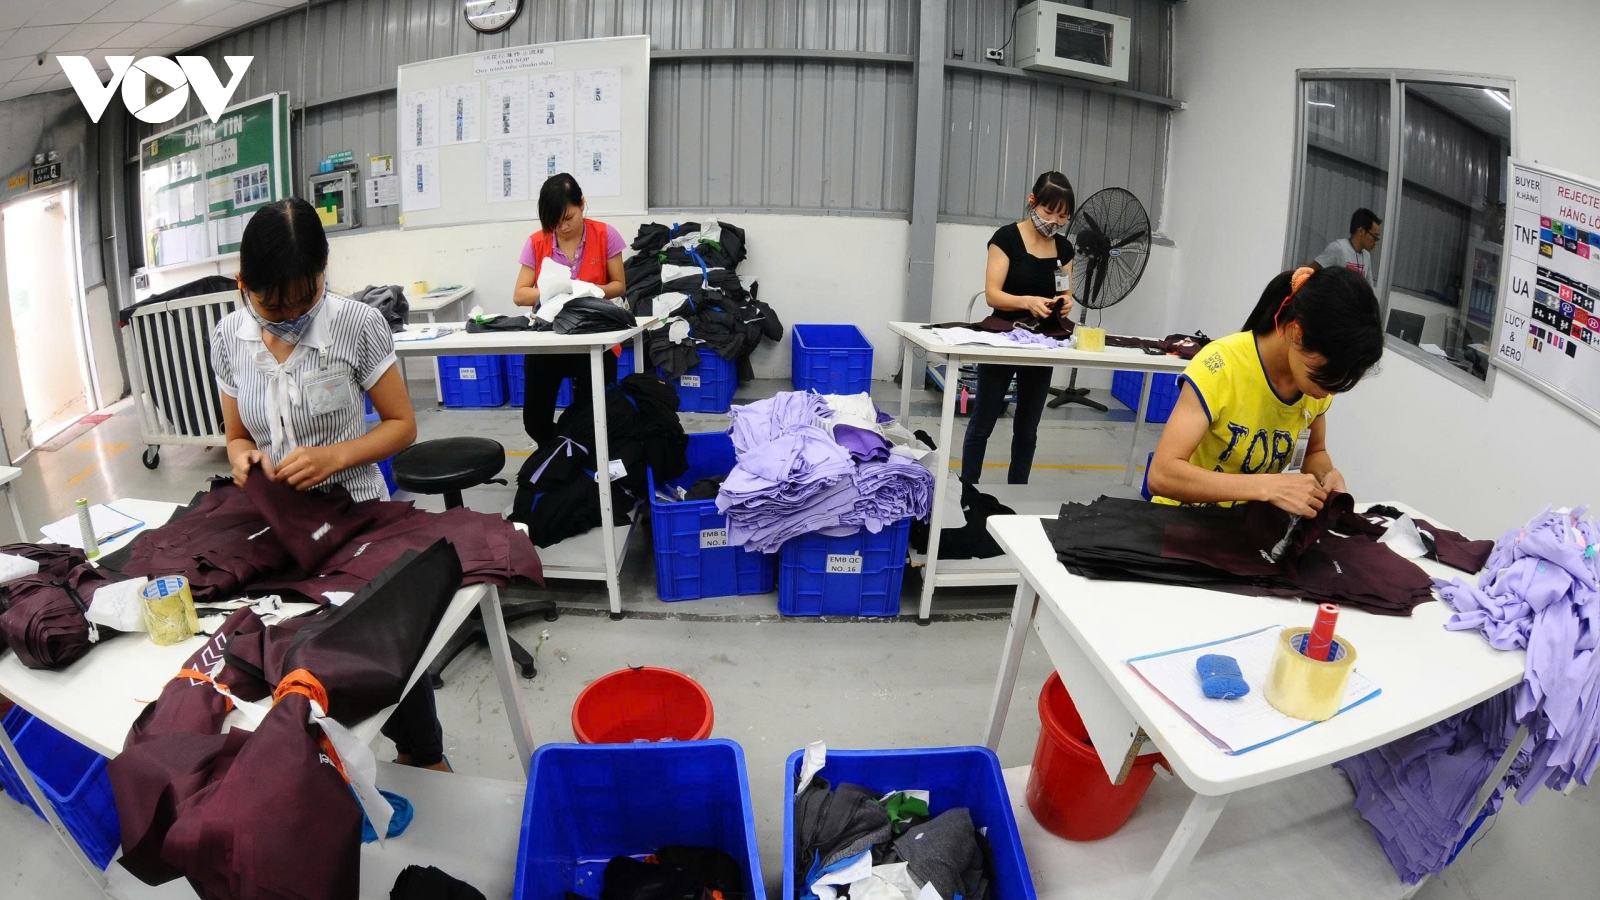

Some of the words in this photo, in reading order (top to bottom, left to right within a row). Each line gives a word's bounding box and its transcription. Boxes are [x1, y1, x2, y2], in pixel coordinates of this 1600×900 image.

[222, 114, 242, 137] TIN
[1515, 176, 1540, 190] BUYER
[1558, 186, 1600, 209] REJECTE
[1514, 224, 1538, 246] TNF
[1512, 276, 1529, 298] UA
[1504, 312, 1525, 330] LUCY
[1509, 332, 1515, 342] &
[1500, 344, 1521, 362] AERO
[1203, 359, 1217, 375] HEART
